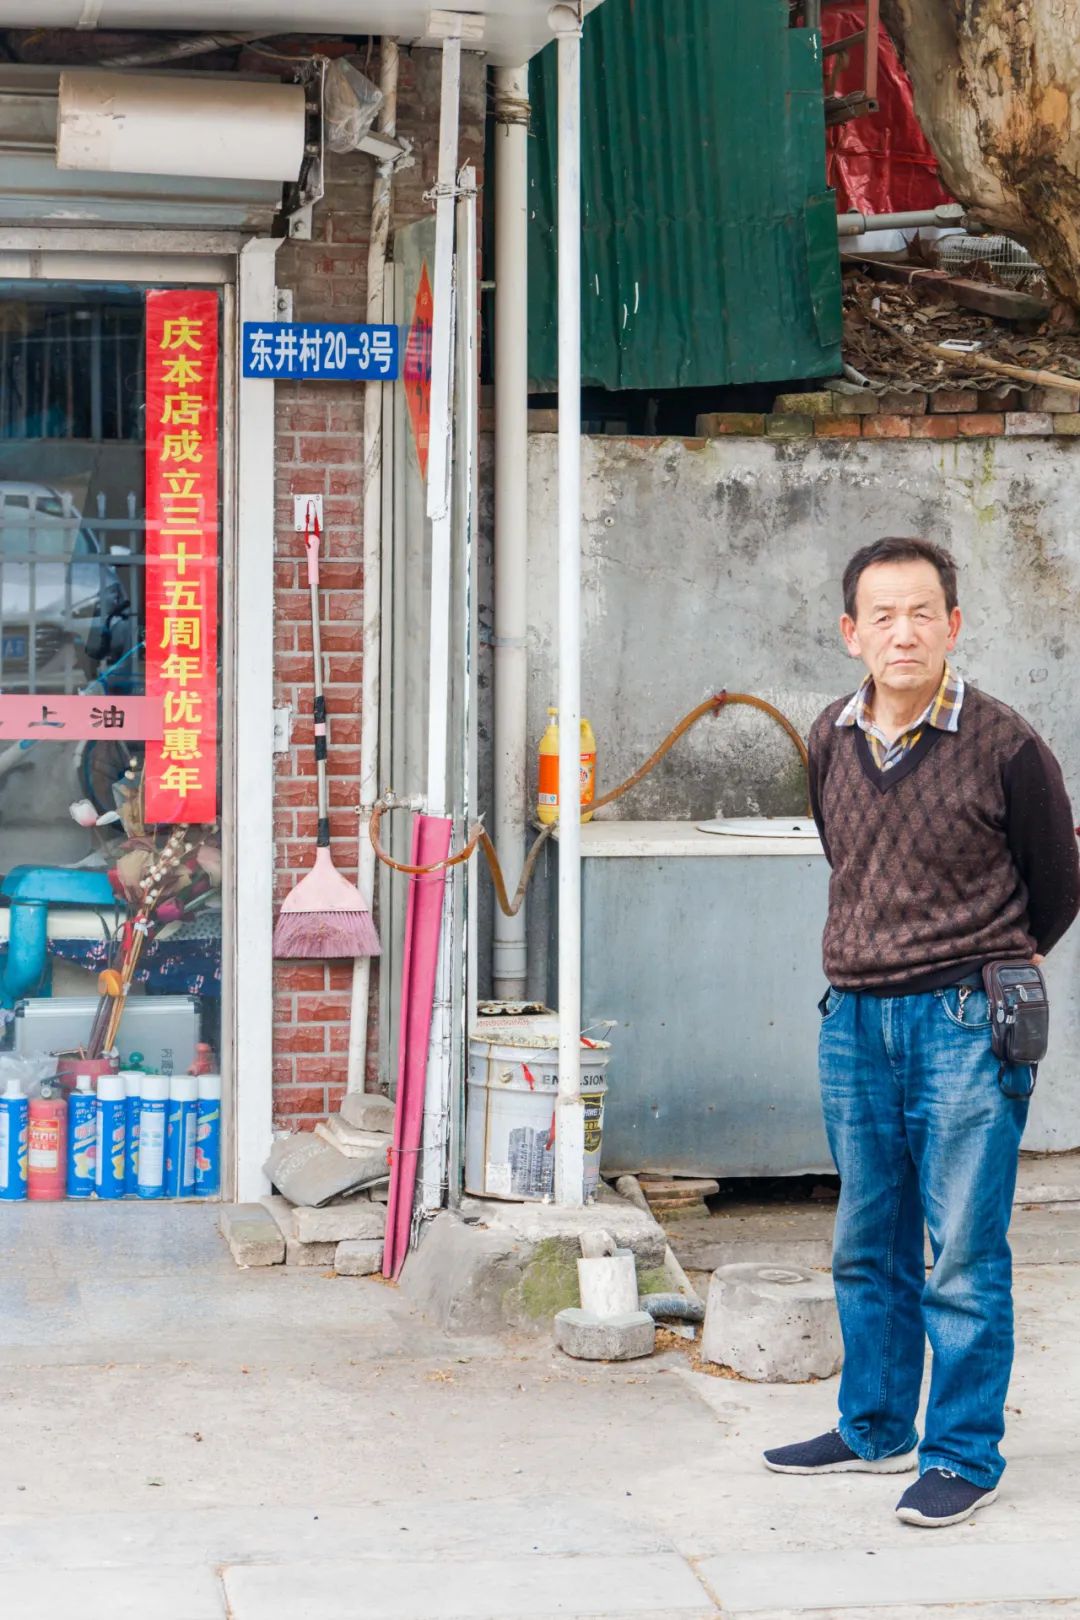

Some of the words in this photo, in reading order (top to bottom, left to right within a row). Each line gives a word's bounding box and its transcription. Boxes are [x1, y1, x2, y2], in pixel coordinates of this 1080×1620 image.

[249, 328, 394, 373] 东井村20-3号
[160, 316, 203, 798] 庆本店成立三十五周年优惠年
[0, 704, 125, 728] 上油
[543, 1075, 605, 1085] ESION
